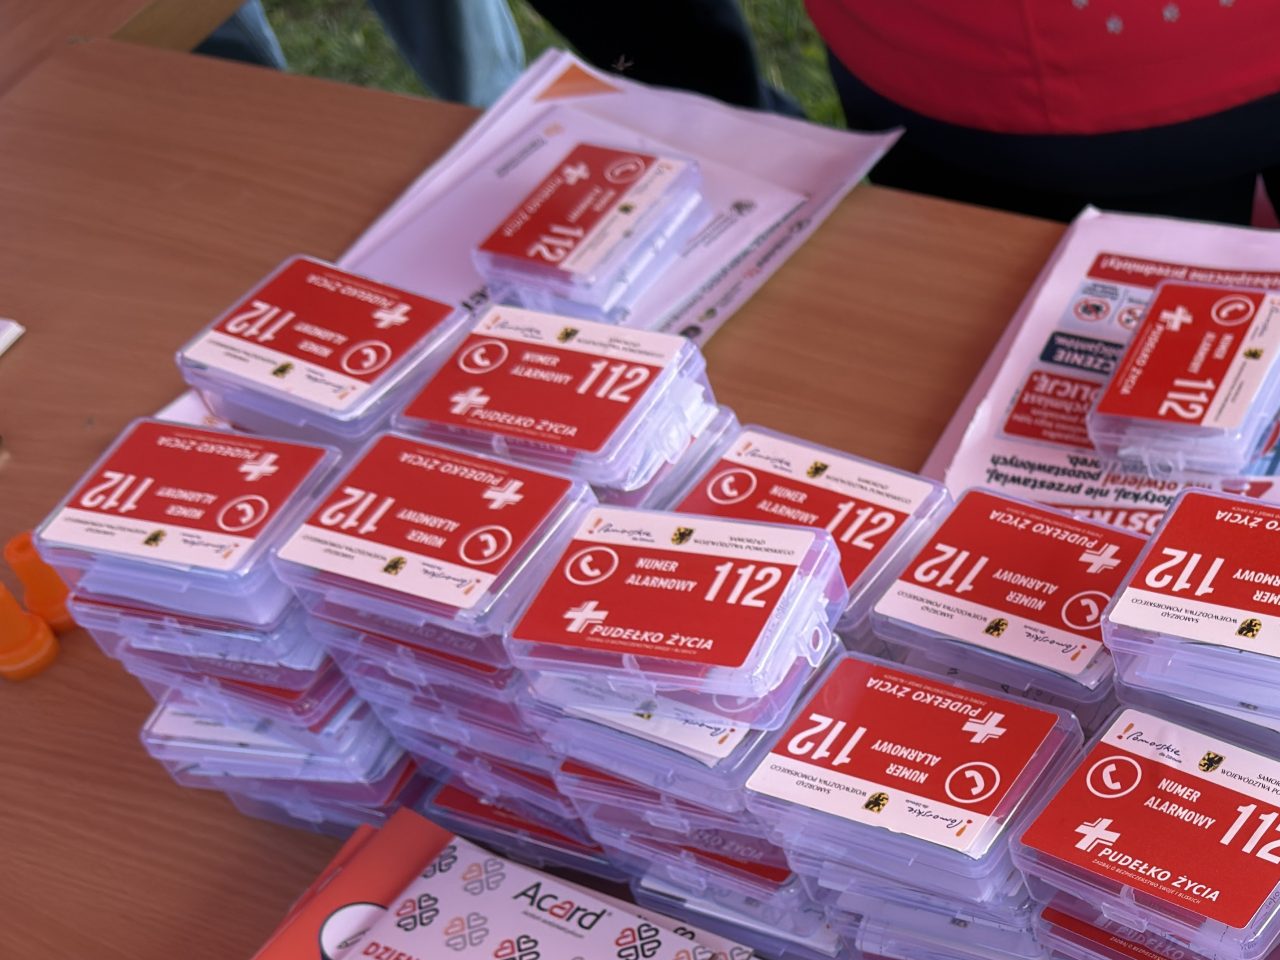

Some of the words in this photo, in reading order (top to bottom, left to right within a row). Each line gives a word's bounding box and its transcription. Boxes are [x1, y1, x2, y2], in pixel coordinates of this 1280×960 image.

[576, 361, 649, 402] 112
[1157, 379, 1214, 418] 112
[399, 452, 440, 469] ŻYCIA
[990, 454, 1102, 483] pozostawionych
[440, 463, 503, 484] PUDEŁKO
[985, 467, 1084, 499] przestawiaj,
[80, 470, 153, 511] 112
[769, 485, 807, 503] NUMER
[319, 486, 395, 533] 112
[396, 508, 460, 531] ALARMOWY
[756, 500, 819, 524] ALARMOWY
[989, 509, 1031, 529] ŻYCIA
[1214, 510, 1262, 527] ŻYCIA
[825, 501, 895, 550] 112
[1031, 523, 1097, 547] PUDEŁKO
[407, 529, 446, 547] NUMER
[635, 558, 678, 572] NUMER
[913, 542, 989, 592] 112
[1144, 546, 1224, 595] 112
[625, 574, 697, 591] ALARMOWY
[705, 562, 781, 607] 112
[992, 568, 1058, 593] ALARMOWY
[1005, 590, 1046, 610] NUMER
[589, 625, 664, 642] PUDEŁKO
[666, 633, 714, 649] ŻYCIA
[865, 677, 911, 697] ŻYCIA
[911, 690, 982, 716] PUDEŁKO
[787, 712, 866, 765] 112
[1126, 732, 1180, 756] Pomorskie
[870, 739, 941, 765] ALARMOWY
[885, 762, 928, 783] NUMER
[1157, 779, 1201, 802] NUMER
[907, 805, 962, 828] Pomorskie
[1143, 796, 1216, 829] ALARMOWY
[1097, 847, 1171, 881] PUDEŁKO
[1171, 875, 1220, 902] ŻYCIA
[512, 882, 607, 930] Acard
